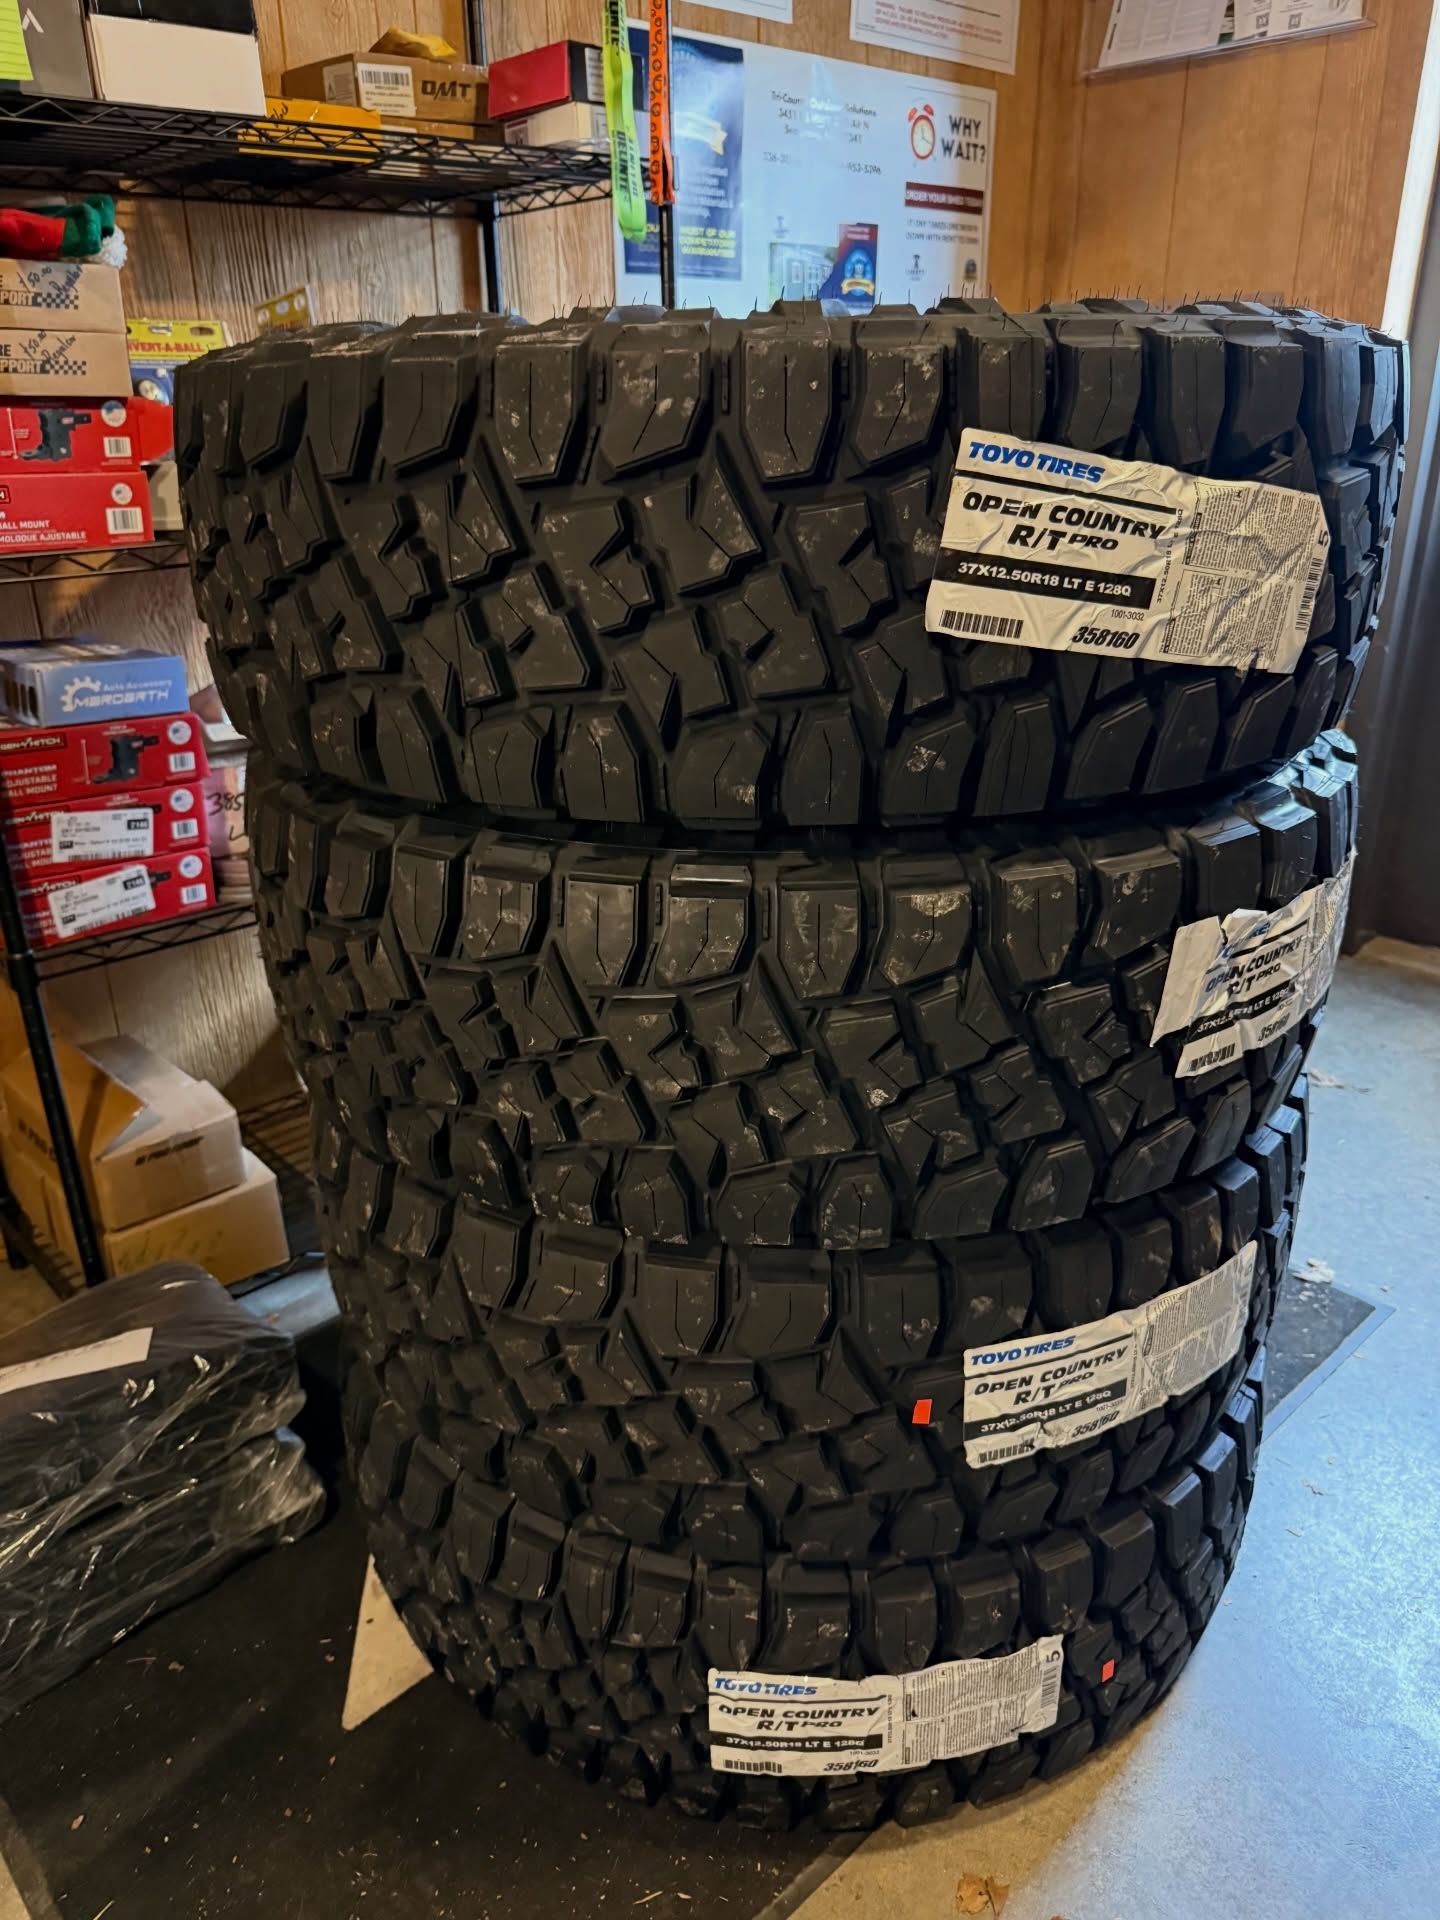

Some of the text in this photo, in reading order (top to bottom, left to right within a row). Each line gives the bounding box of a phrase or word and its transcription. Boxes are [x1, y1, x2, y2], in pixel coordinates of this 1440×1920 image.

[949, 114, 982, 138] WHY
[941, 137, 986, 163] WAIT?
[615, 130, 630, 194] DELINTE
[968, 441, 1106, 483] TOYO TIRES
[20, 520, 50, 529] MOUNT
[962, 491, 1166, 540] OPEN COUNTRY
[39, 531, 87, 541] AJUSTABLE
[1007, 524, 1119, 551] R/T PRO
[1318, 530, 1329, 548] 5
[958, 562, 1132, 597] 37X12.50R18 LT E 128Q
[1111, 608, 1145, 622] 1001-3032
[1072, 625, 1141, 650] 358160
[7, 774, 57, 788] DJUSTABLE
[26, 783, 57, 795] MOUNT
[1256, 963, 1282, 982] PRO
[971, 1335, 1076, 1366] TOYO TIRES
[974, 1345, 1128, 1396] OPEN COUNTRY
[1013, 1371, 1094, 1405] R/T PRO
[980, 1390, 1112, 1432] 37X12.50R18 LT E 128Q
[1071, 1410, 1120, 1439] 358160
[1046, 1650, 1060, 1663] 5
[714, 1677, 818, 1696] TOYO TIRES
[718, 1704, 881, 1719] OPEN COUNTRY
[756, 1720, 843, 1732] R/T PRO
[804, 1740, 820, 1749] LT
[822, 1740, 832, 1749] E
[823, 1759, 879, 1772] 358160
